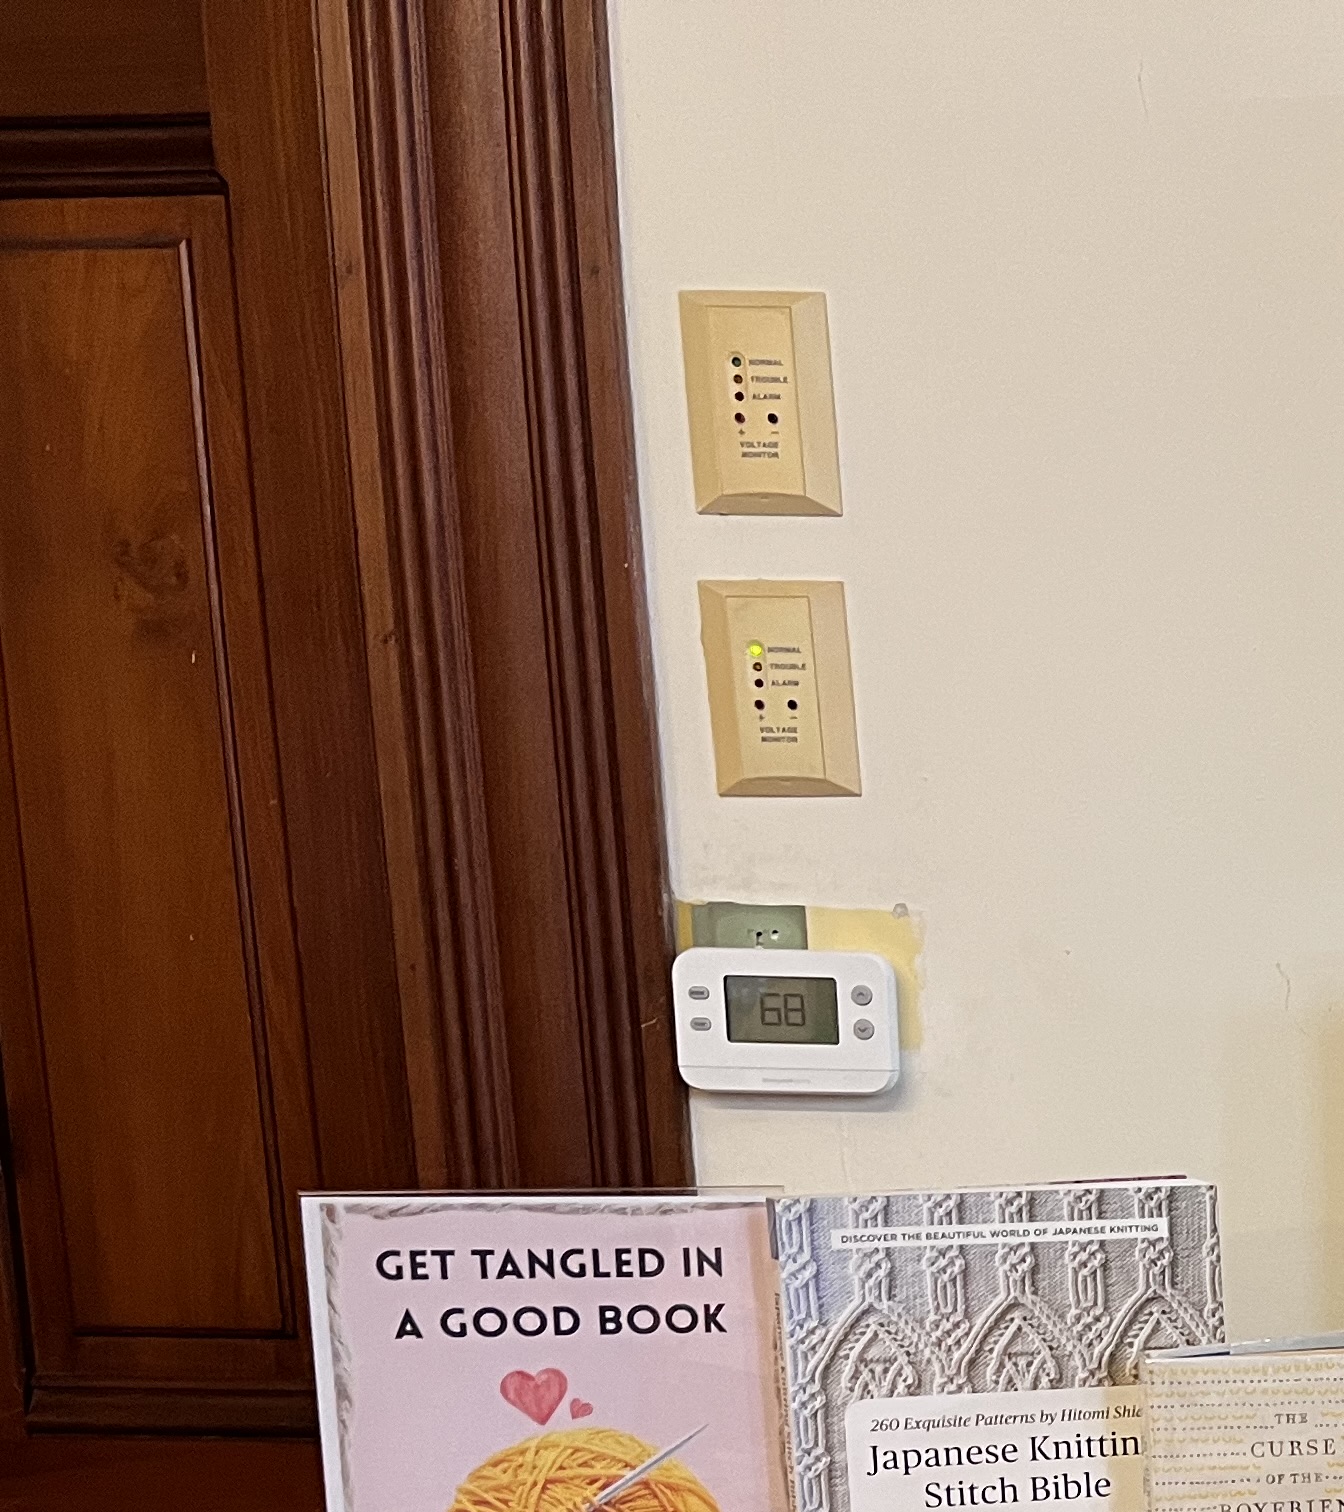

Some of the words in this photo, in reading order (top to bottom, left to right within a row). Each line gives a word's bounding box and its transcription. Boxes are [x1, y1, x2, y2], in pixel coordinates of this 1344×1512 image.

[739, 441, 779, 449] VOLTAGE
[760, 992, 806, 1026] 68
[841, 1233, 898, 1244] DISCOVER
[901, 1232, 922, 1241] THE
[926, 1230, 986, 1240] BEAUTIFUL
[990, 1227, 1031, 1239] WORLD
[1033, 1227, 1048, 1237] OF
[1052, 1225, 1107, 1237] JAPANESE
[1109, 1224, 1159, 1234] KNITTING
[374, 1248, 456, 1281] GET
[471, 1246, 666, 1281] TANGLED
[682, 1246, 724, 1278] IN
[394, 1308, 424, 1340] A
[439, 1306, 581, 1339] GOOD
[598, 1303, 728, 1336] BOOK
[870, 1418, 900, 1432] 260
[903, 1415, 971, 1433] Exquisite
[974, 1410, 1036, 1427] Patterns
[1039, 1409, 1057, 1426] by
[1060, 1406, 1110, 1422] Hitomi
[1274, 1412, 1308, 1424] THE
[866, 1441, 1019, 1476] Japanese
[1030, 1431, 1142, 1462] Knittin
[1251, 1438, 1336, 1458] CURSE
[925, 1476, 1019, 1509] Stitch
[1030, 1472, 1112, 1502] Bible
[1266, 1474, 1285, 1485] OF
[1290, 1473, 1323, 1484] THE
